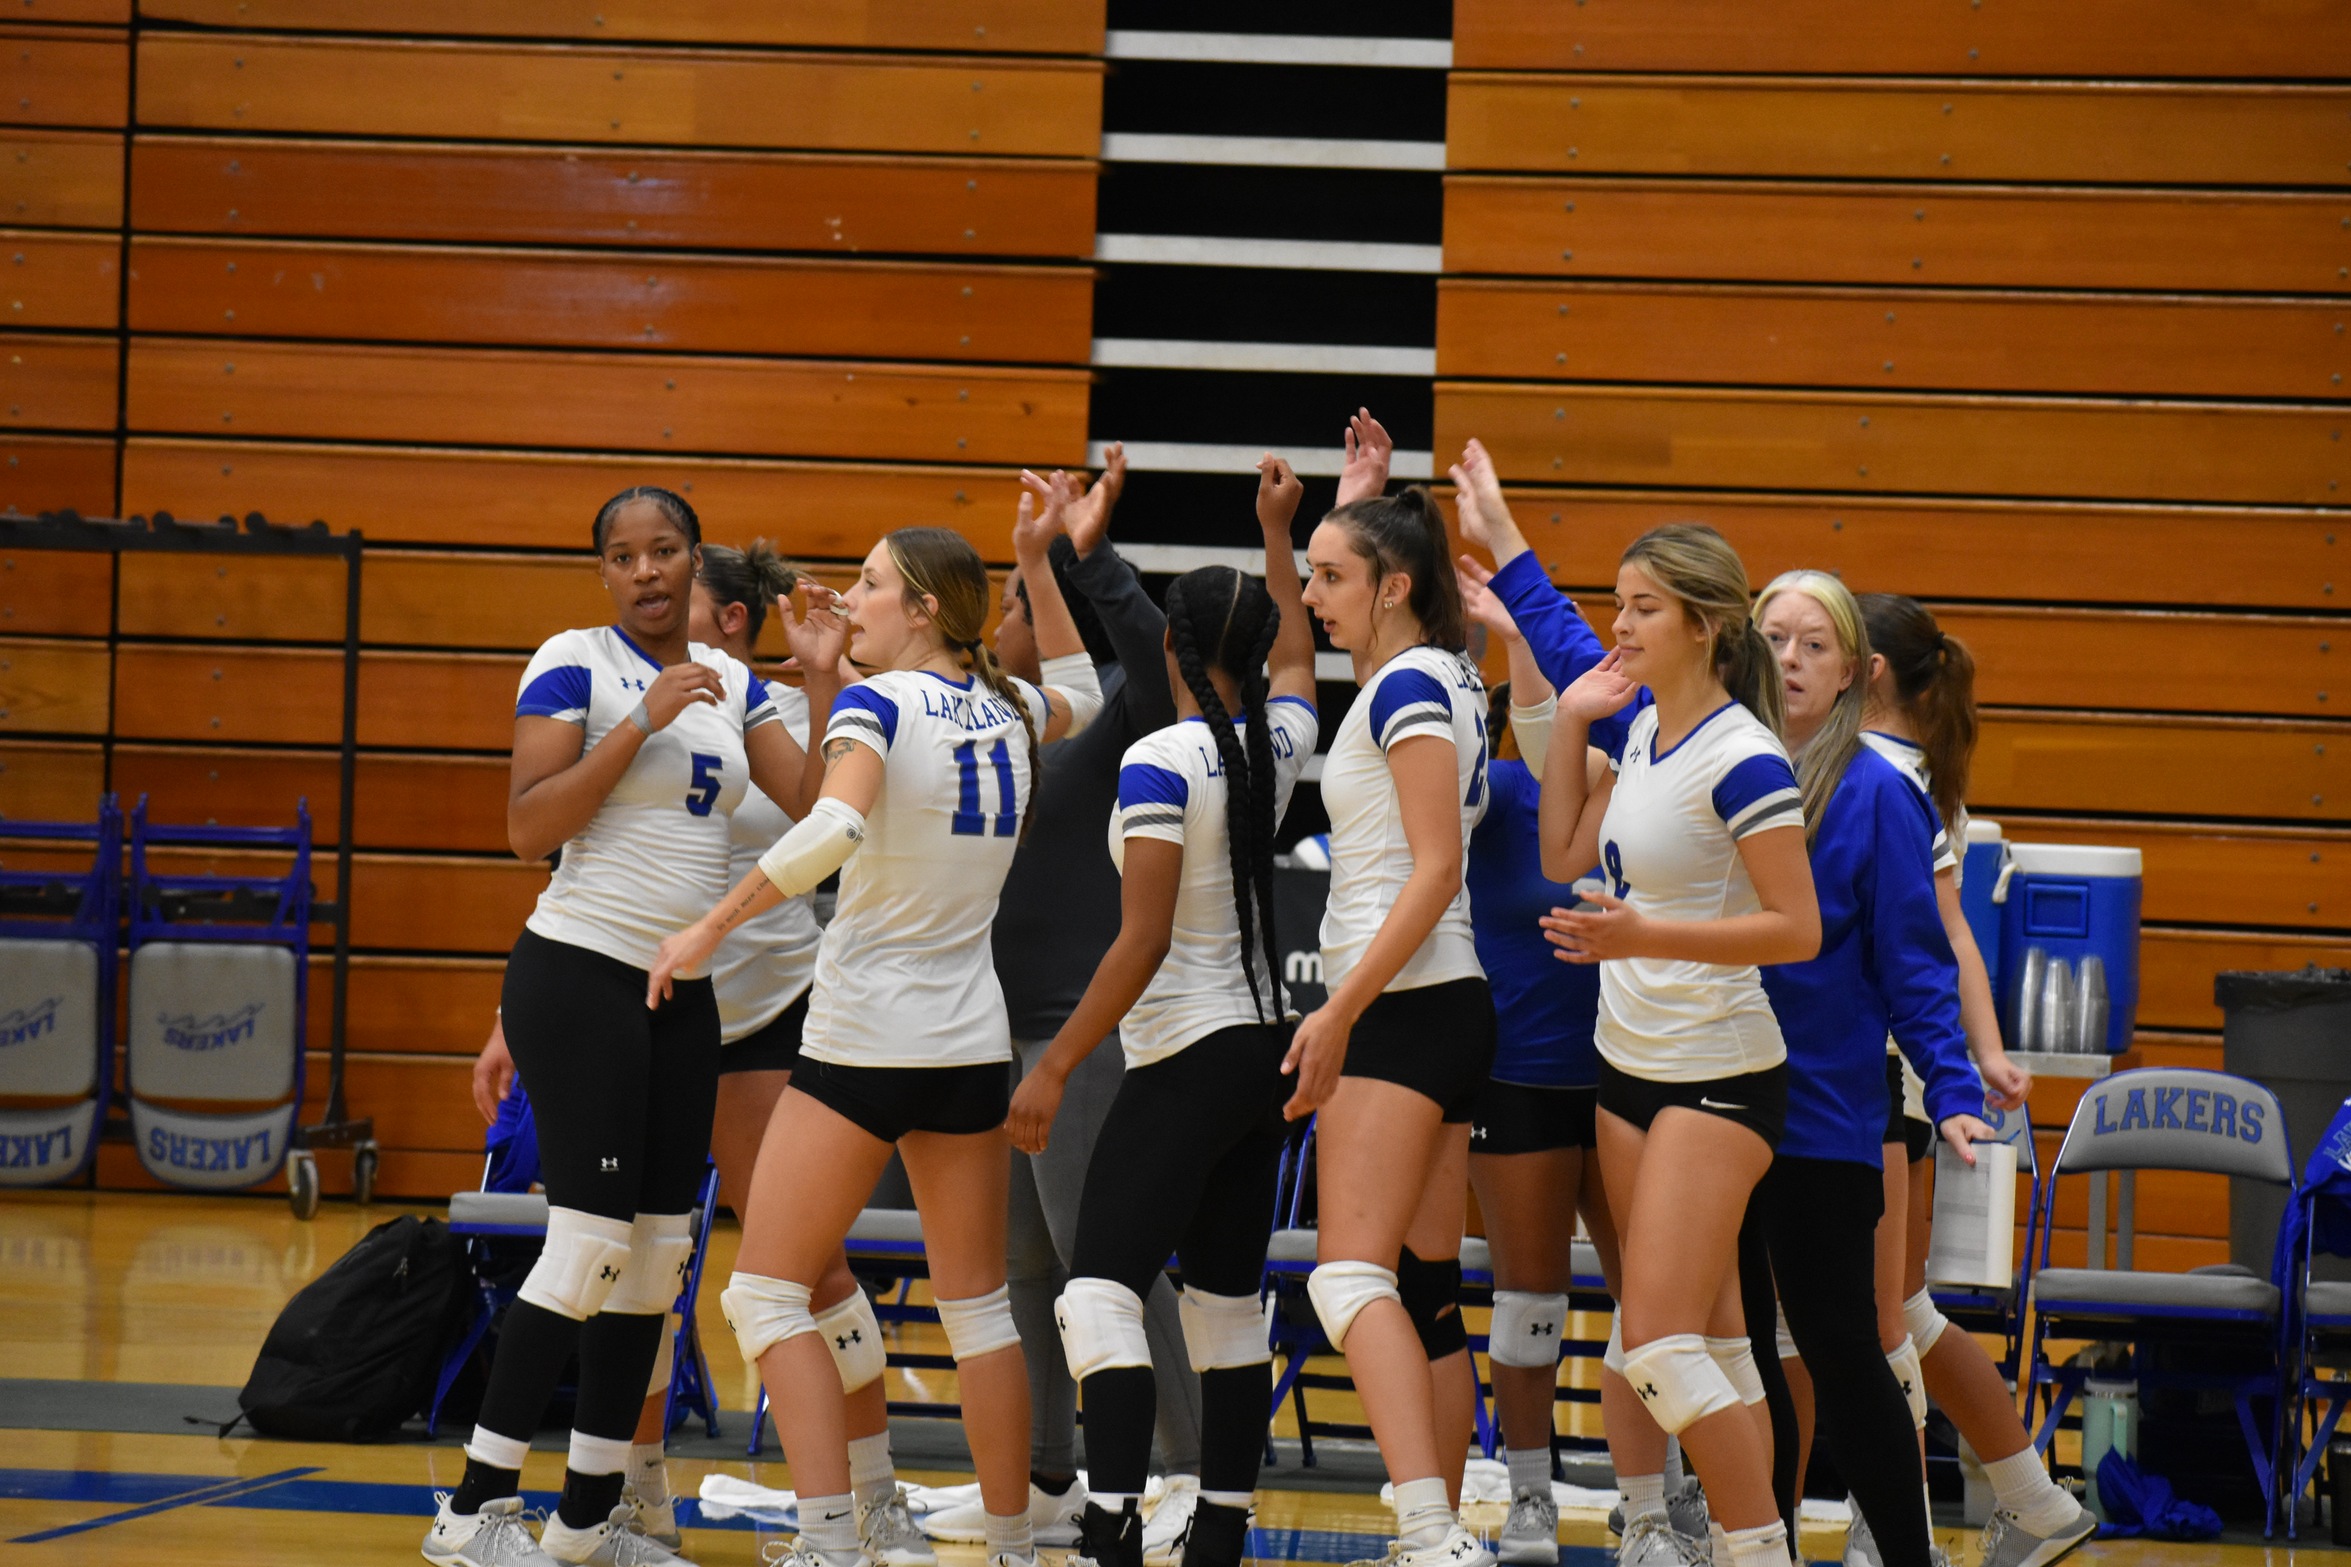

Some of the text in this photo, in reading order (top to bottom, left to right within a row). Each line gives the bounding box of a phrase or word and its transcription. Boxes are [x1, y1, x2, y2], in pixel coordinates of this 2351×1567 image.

[920, 689, 1021, 731] LAKLAN
[685, 751, 723, 817] 5
[951, 738, 1017, 837] 11
[2094, 1086, 2265, 1144] LAKERS
[150, 1127, 271, 1170] LAKERS
